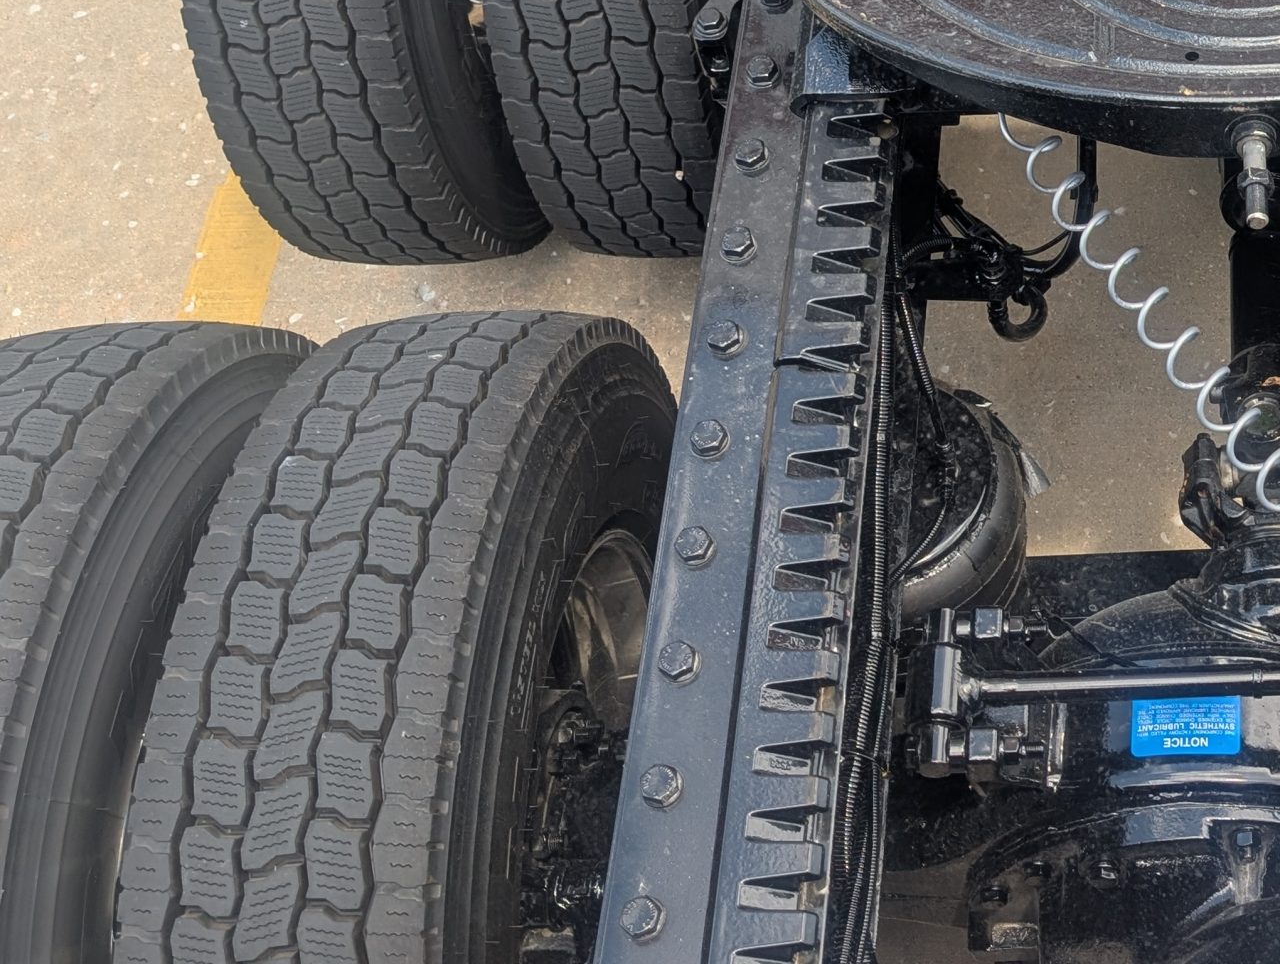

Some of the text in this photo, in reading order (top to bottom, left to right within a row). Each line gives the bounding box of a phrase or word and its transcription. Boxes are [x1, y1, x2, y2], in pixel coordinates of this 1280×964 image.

[1137, 722, 1236, 732] SYNTHETIC LUBRICANT
[1163, 737, 1209, 748] NOTICE
